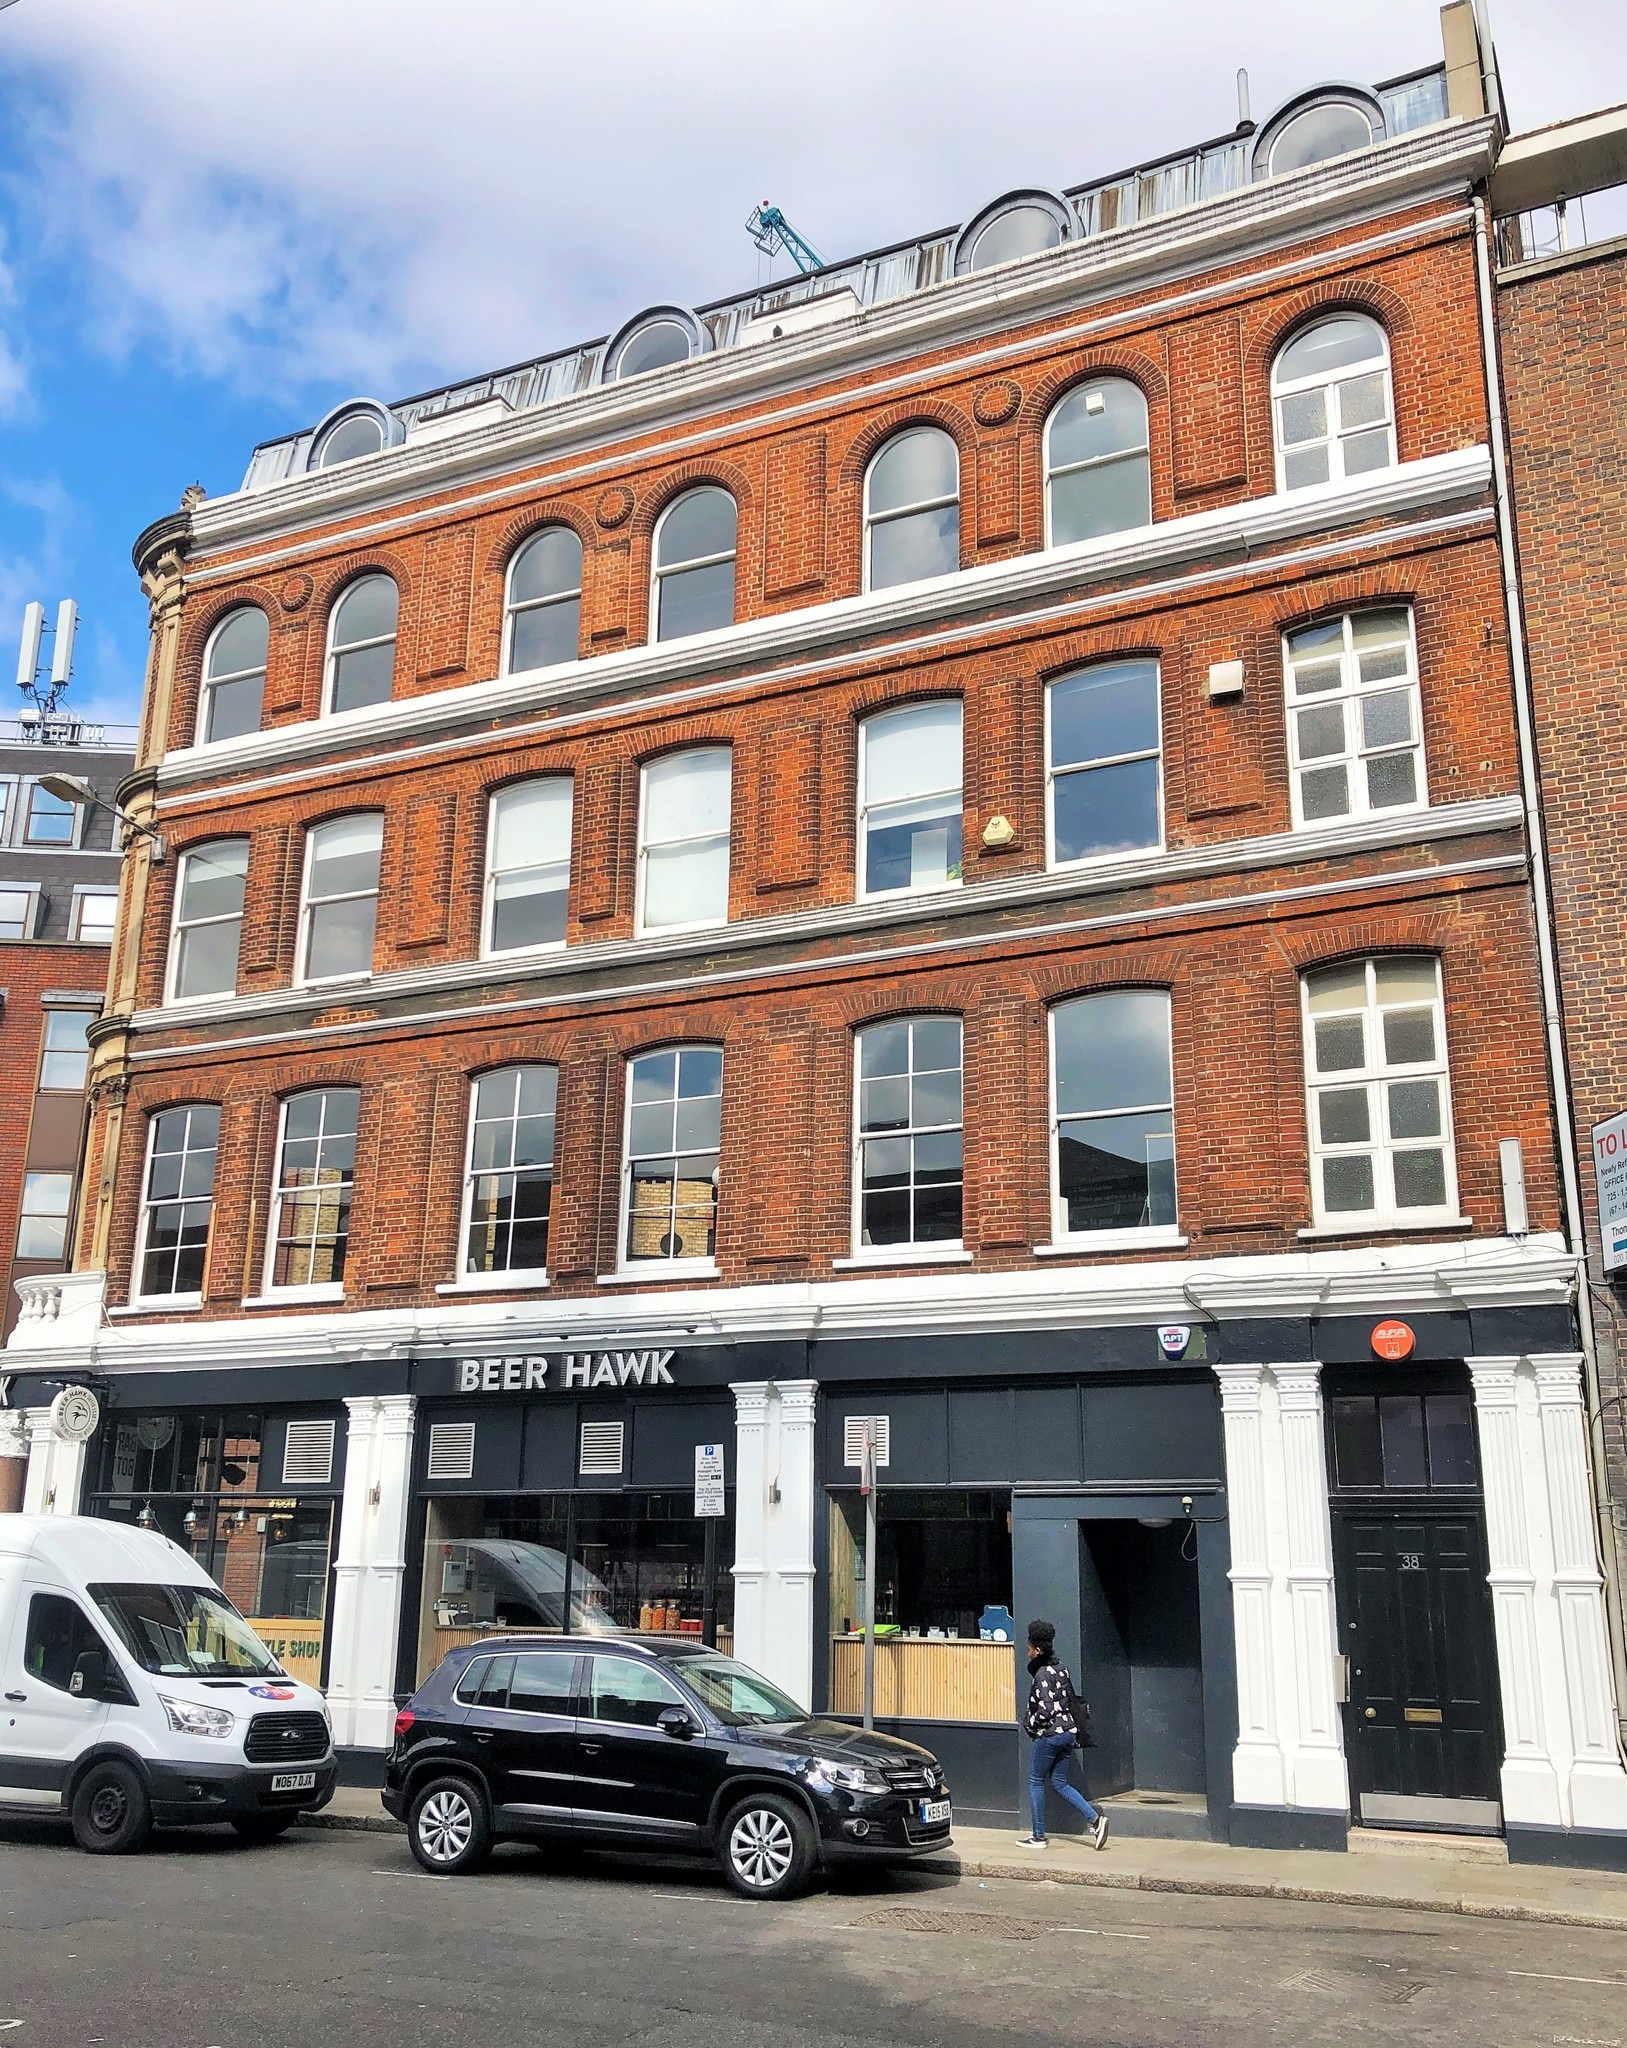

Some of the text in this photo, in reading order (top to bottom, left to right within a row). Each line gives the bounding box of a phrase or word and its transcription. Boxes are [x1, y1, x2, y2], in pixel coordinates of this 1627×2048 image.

[1597, 1133, 1617, 1158] TO
[1601, 1163, 1616, 1176] Newly
[1604, 1170, 1624, 1189] OFFICE
[1606, 1190, 1616, 1202] 725
[1164, 1334, 1182, 1342] APT
[461, 1350, 675, 1391] BEER HAWK
[59, 1390, 88, 1416] BEER HAWK
[1401, 1555, 1420, 1569] 38
[289, 1640, 320, 1659] SHOP
[298, 1774, 313, 1786] DJX
